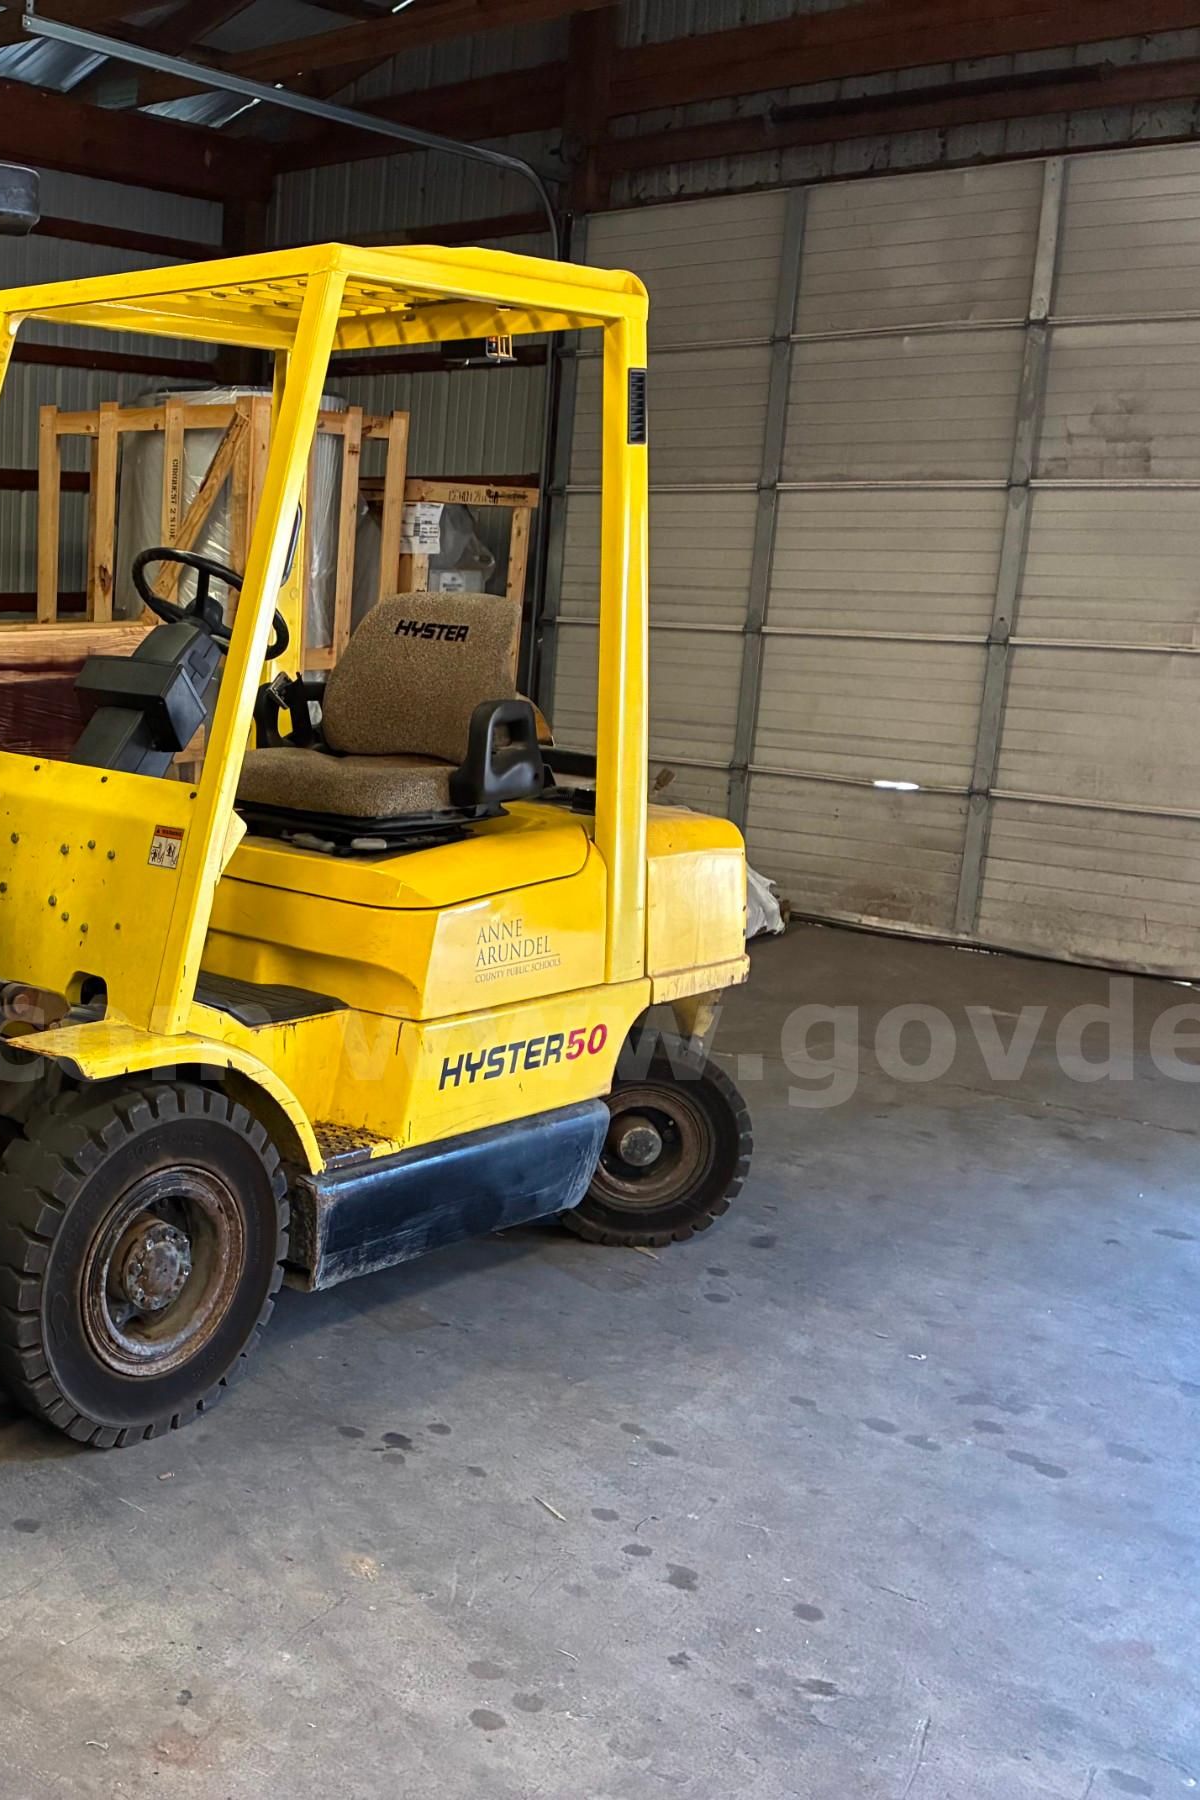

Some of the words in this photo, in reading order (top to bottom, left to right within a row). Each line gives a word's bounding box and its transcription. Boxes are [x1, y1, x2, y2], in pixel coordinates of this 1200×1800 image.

[394, 619, 469, 642] HYSTER
[476, 918, 523, 945] ANNE
[476, 935, 551, 967] ARUNDEL
[475, 969, 505, 984] COUNTY
[506, 964, 531, 977] PUBLIC
[531, 957, 561, 973] SCHOOLS
